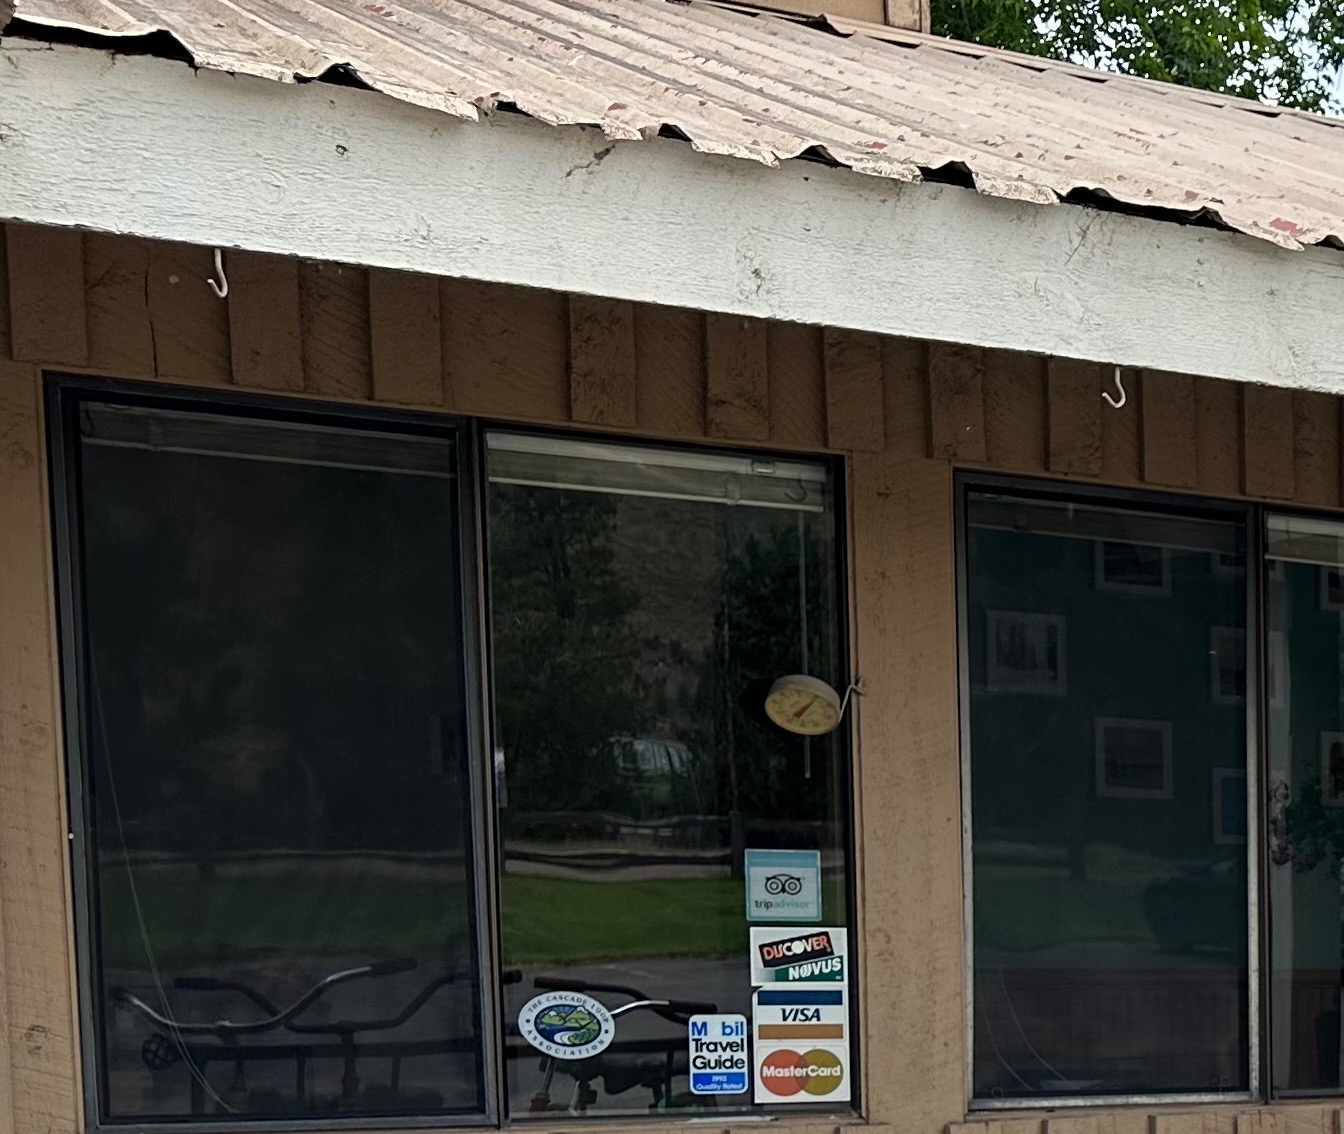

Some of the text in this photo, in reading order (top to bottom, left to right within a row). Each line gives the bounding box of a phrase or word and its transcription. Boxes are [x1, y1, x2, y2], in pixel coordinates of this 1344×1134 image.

[754, 899, 810, 910] tripadvisor
[763, 935, 829, 960] DISCOVER
[788, 957, 841, 980] NOVUS
[528, 999, 543, 1013] THE
[546, 994, 587, 1005] CASCADE
[781, 1008, 821, 1022] VISA
[691, 1021, 744, 1036] Mbil
[527, 1029, 605, 1056] ASSOCIATION
[692, 1038, 745, 1053] Travel
[692, 1055, 745, 1070] Guide
[763, 1065, 840, 1077] MasterCard
